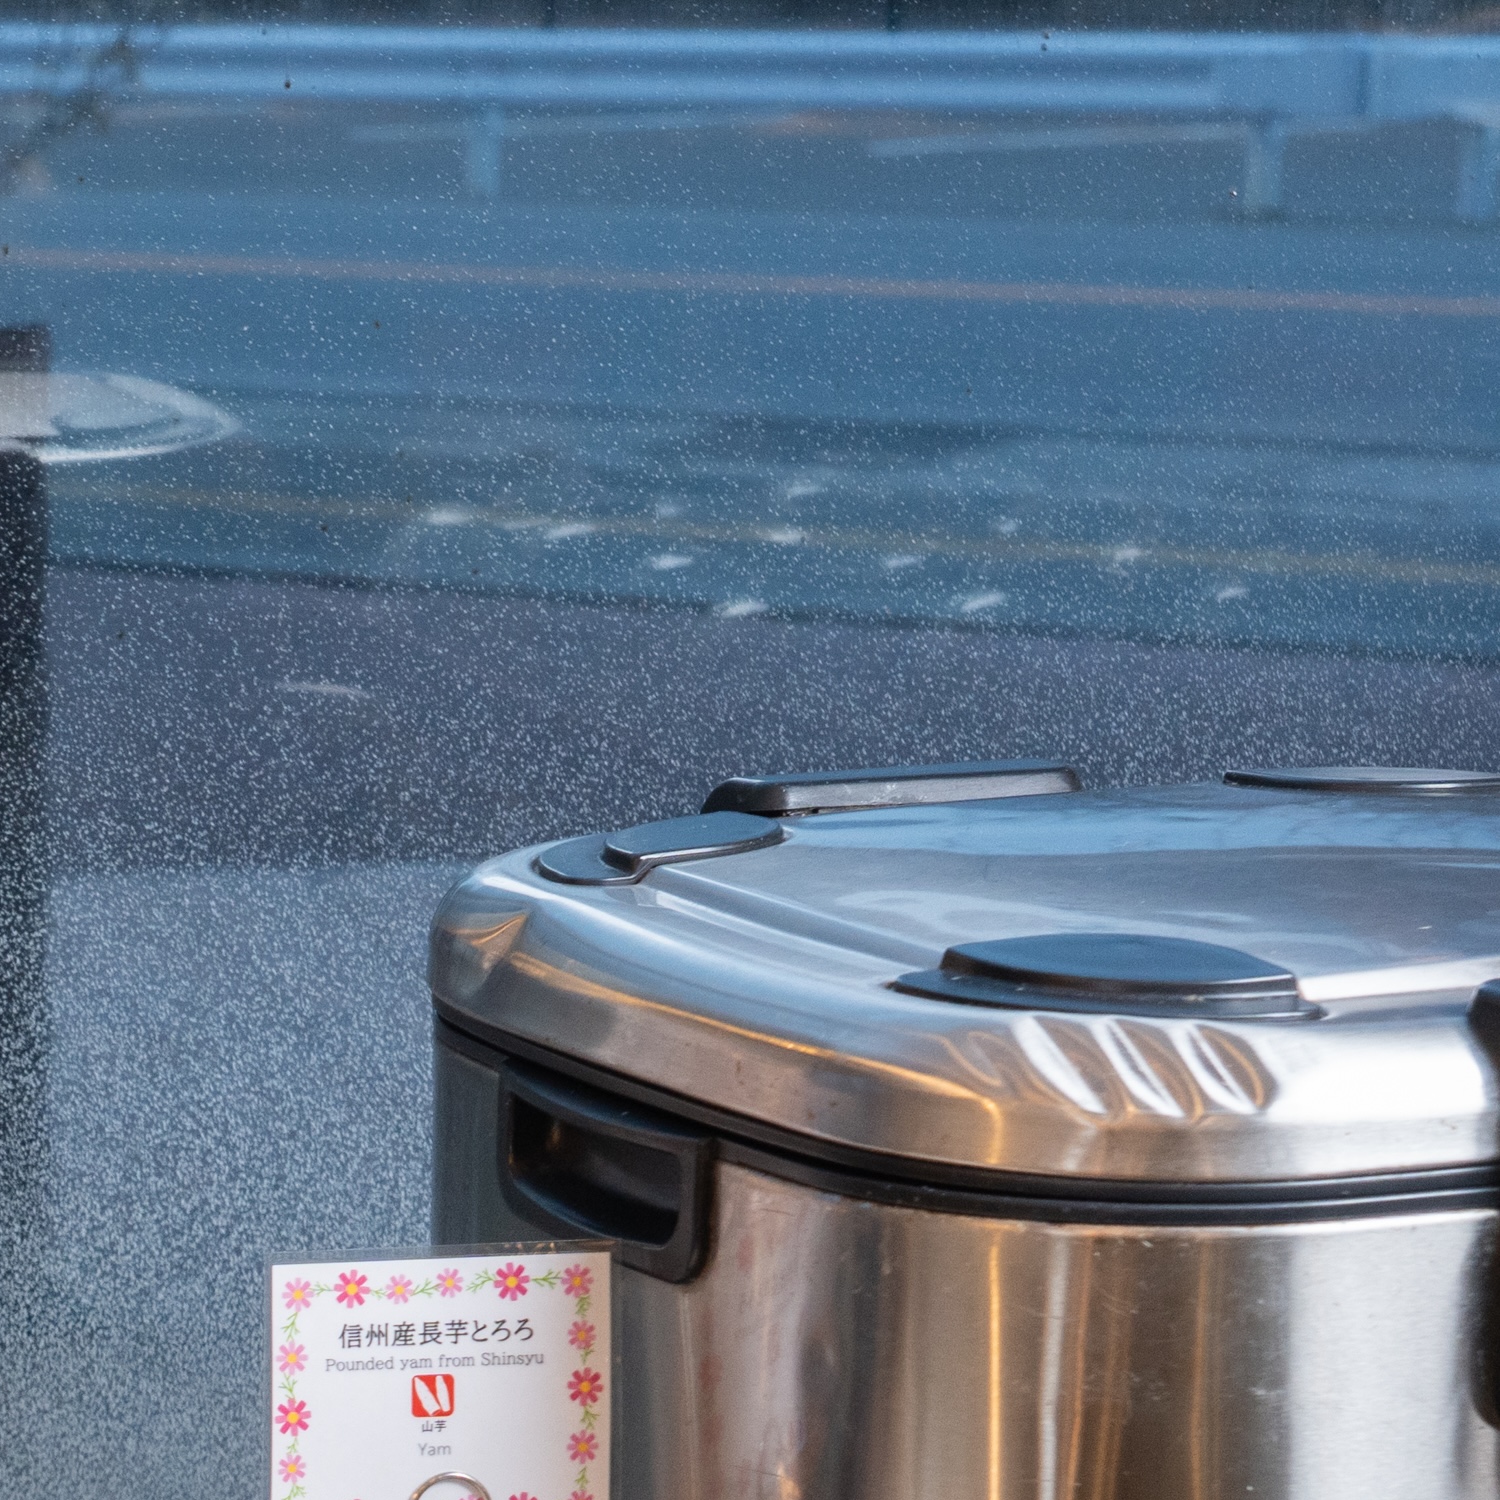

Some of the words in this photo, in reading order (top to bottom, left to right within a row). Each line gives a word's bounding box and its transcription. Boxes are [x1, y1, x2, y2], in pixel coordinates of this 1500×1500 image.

[339, 1318, 535, 1349] 信州産長芋とろろ
[325, 1356, 394, 1372] Pounded
[399, 1357, 433, 1371] yam
[438, 1354, 475, 1367] from
[481, 1352, 545, 1367] Shinsyu
[421, 1420, 447, 1433] 山芋
[418, 1442, 452, 1456] Yam
